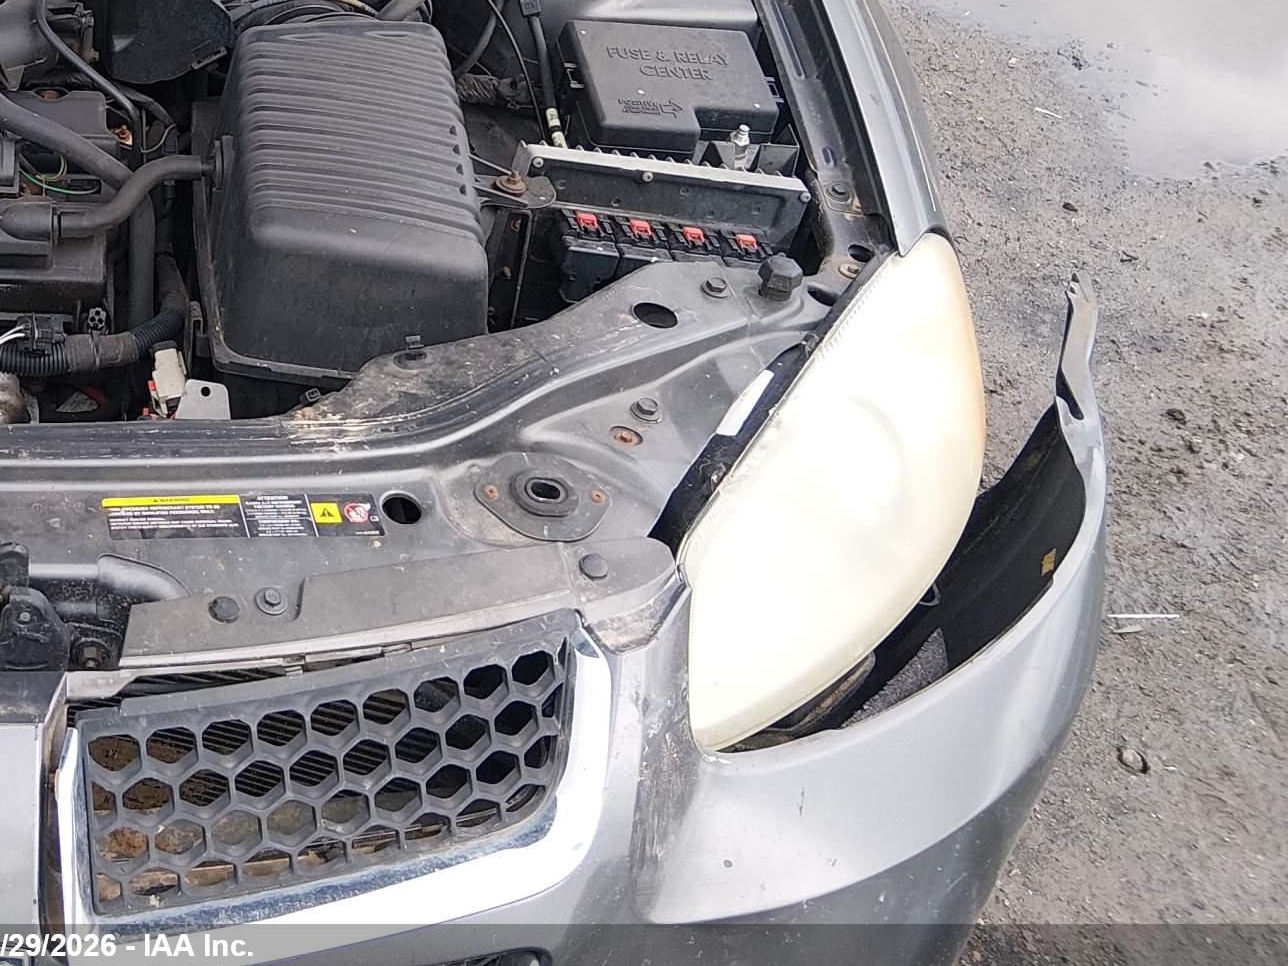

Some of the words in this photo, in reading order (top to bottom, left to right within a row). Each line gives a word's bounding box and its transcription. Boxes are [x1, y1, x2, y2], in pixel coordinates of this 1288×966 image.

[606, 46, 652, 61] FUSE
[655, 49, 671, 62] &
[673, 51, 729, 66] RELAY
[639, 65, 713, 81] CENTER
